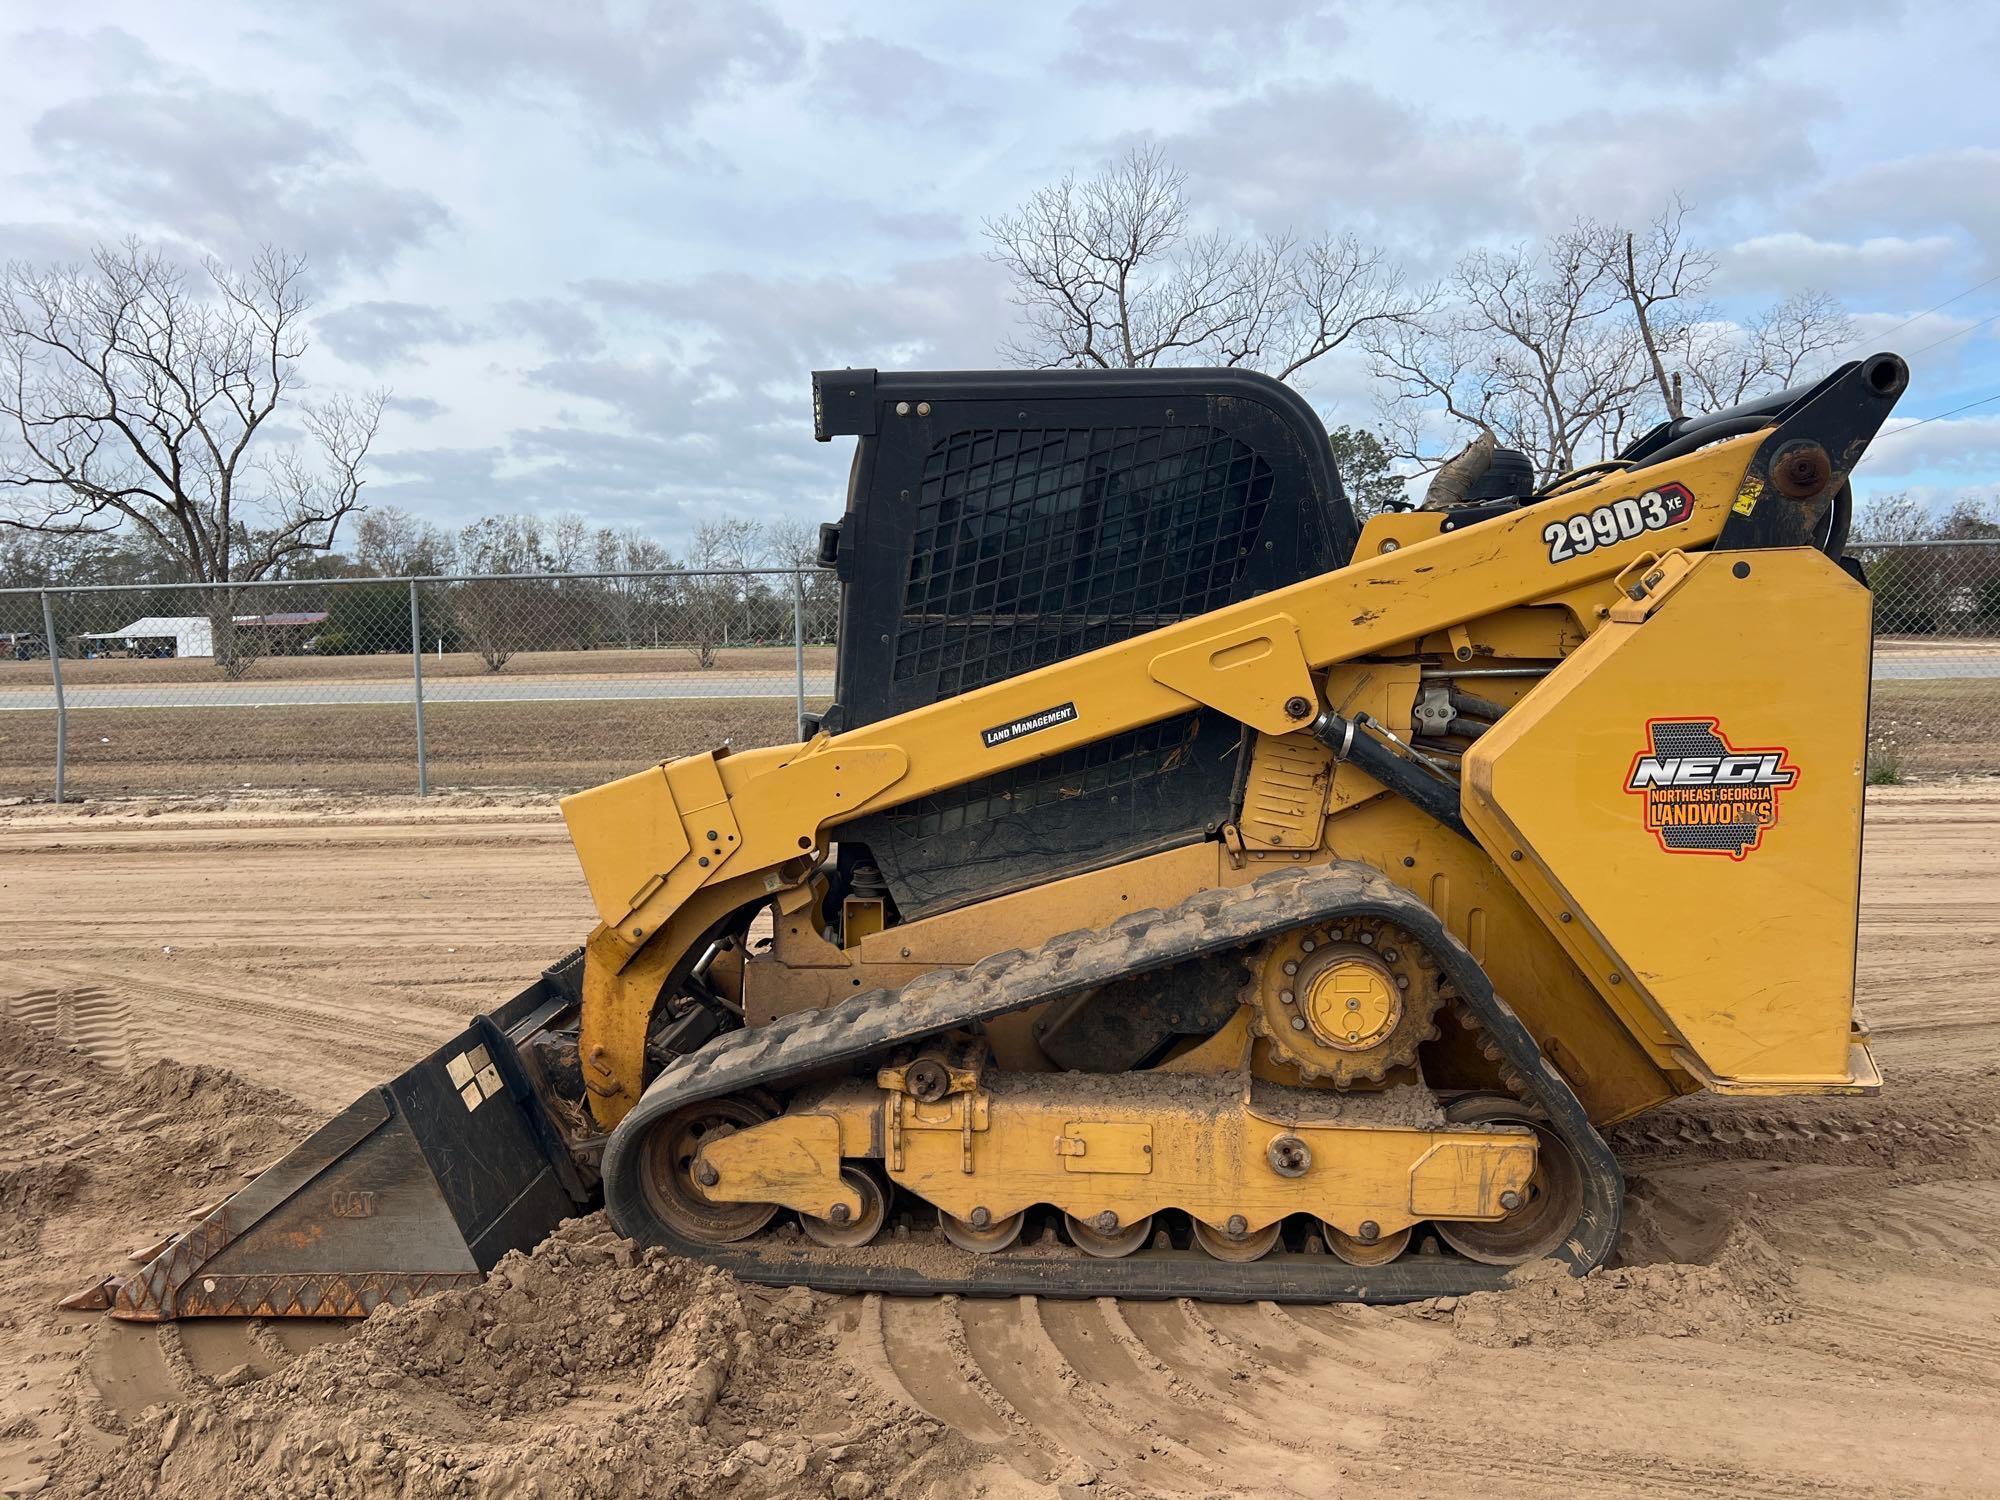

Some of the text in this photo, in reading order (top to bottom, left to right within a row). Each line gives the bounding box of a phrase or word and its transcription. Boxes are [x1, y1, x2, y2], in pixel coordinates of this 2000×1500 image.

[1544, 490, 1683, 562] 299D3 XE
[987, 707, 1072, 744] LAND MANAGEMENT
[1632, 755, 1792, 787] NEGL
[1651, 787, 1771, 803] NORTHEAST GEORGIA
[331, 1190, 375, 1218] CAT
